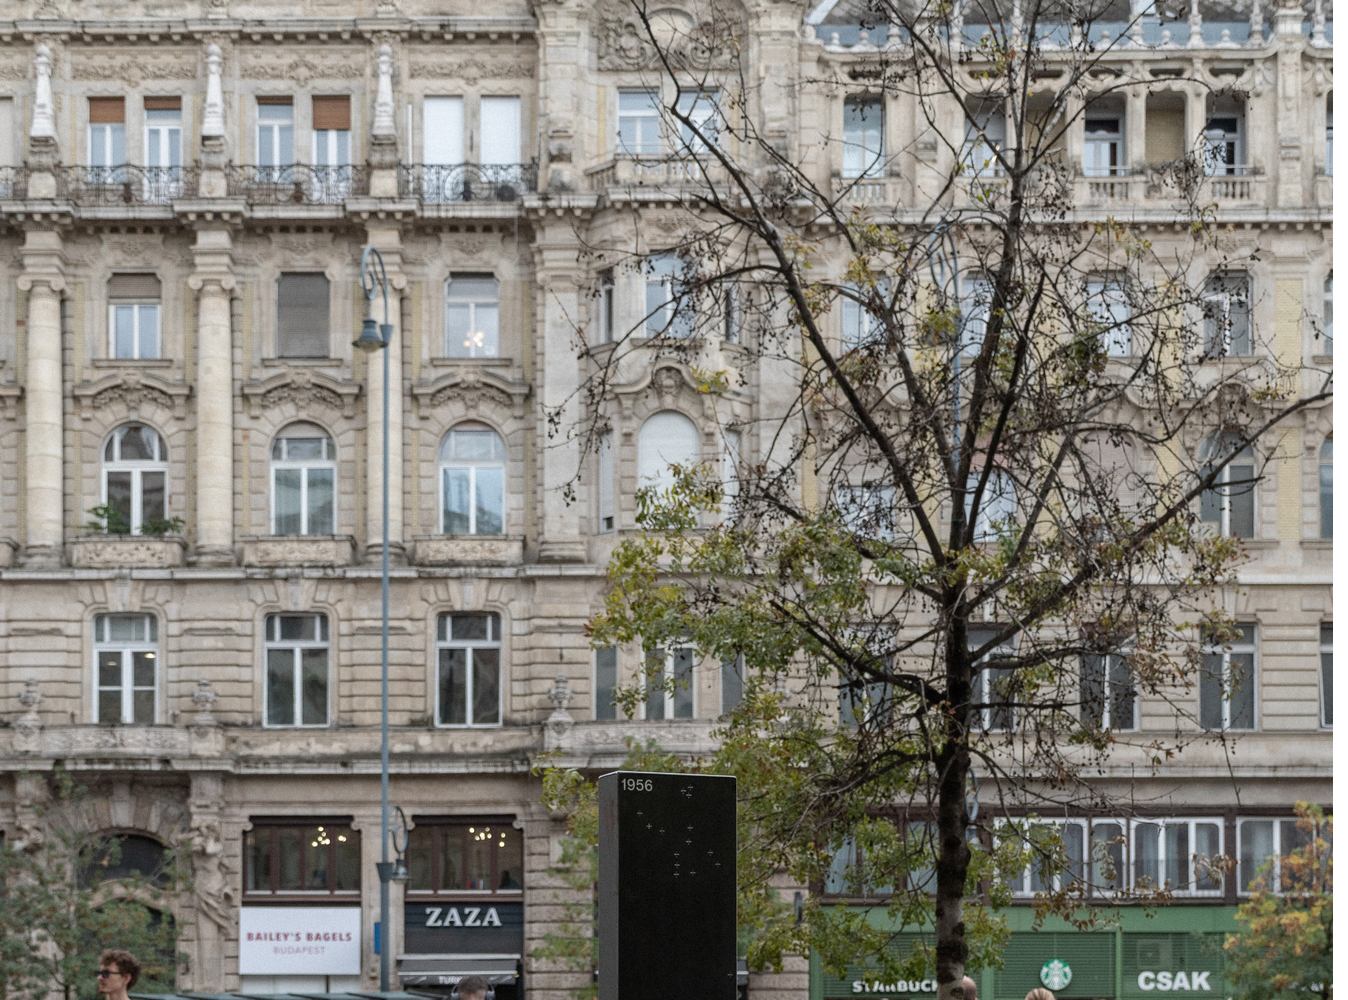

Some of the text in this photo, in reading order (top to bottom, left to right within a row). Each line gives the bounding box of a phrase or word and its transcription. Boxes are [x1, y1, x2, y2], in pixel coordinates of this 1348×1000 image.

[621, 778, 653, 792] 1956
[425, 907, 502, 927] ZAZA
[246, 932, 352, 942] BAILEY'S BAGELS
[273, 946, 326, 955] BUDAPEST
[1137, 970, 1211, 992] CSAK
